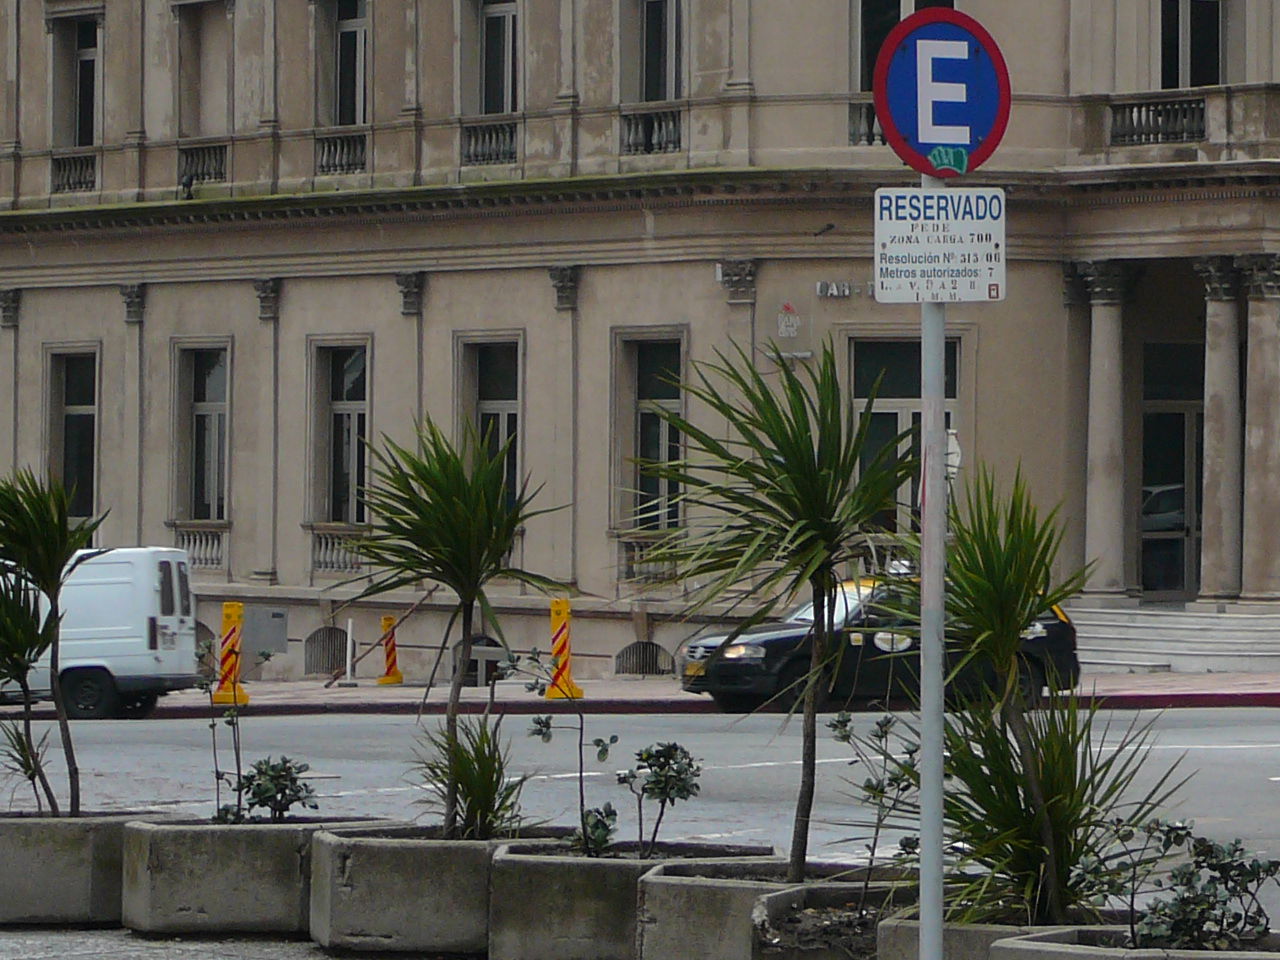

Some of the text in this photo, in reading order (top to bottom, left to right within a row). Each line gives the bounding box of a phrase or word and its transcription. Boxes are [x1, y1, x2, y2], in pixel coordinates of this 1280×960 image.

[916, 39, 971, 144] E
[879, 194, 1002, 221] RESERVADO
[879, 252, 940, 264] Resolución
[879, 267, 917, 279] Metros
